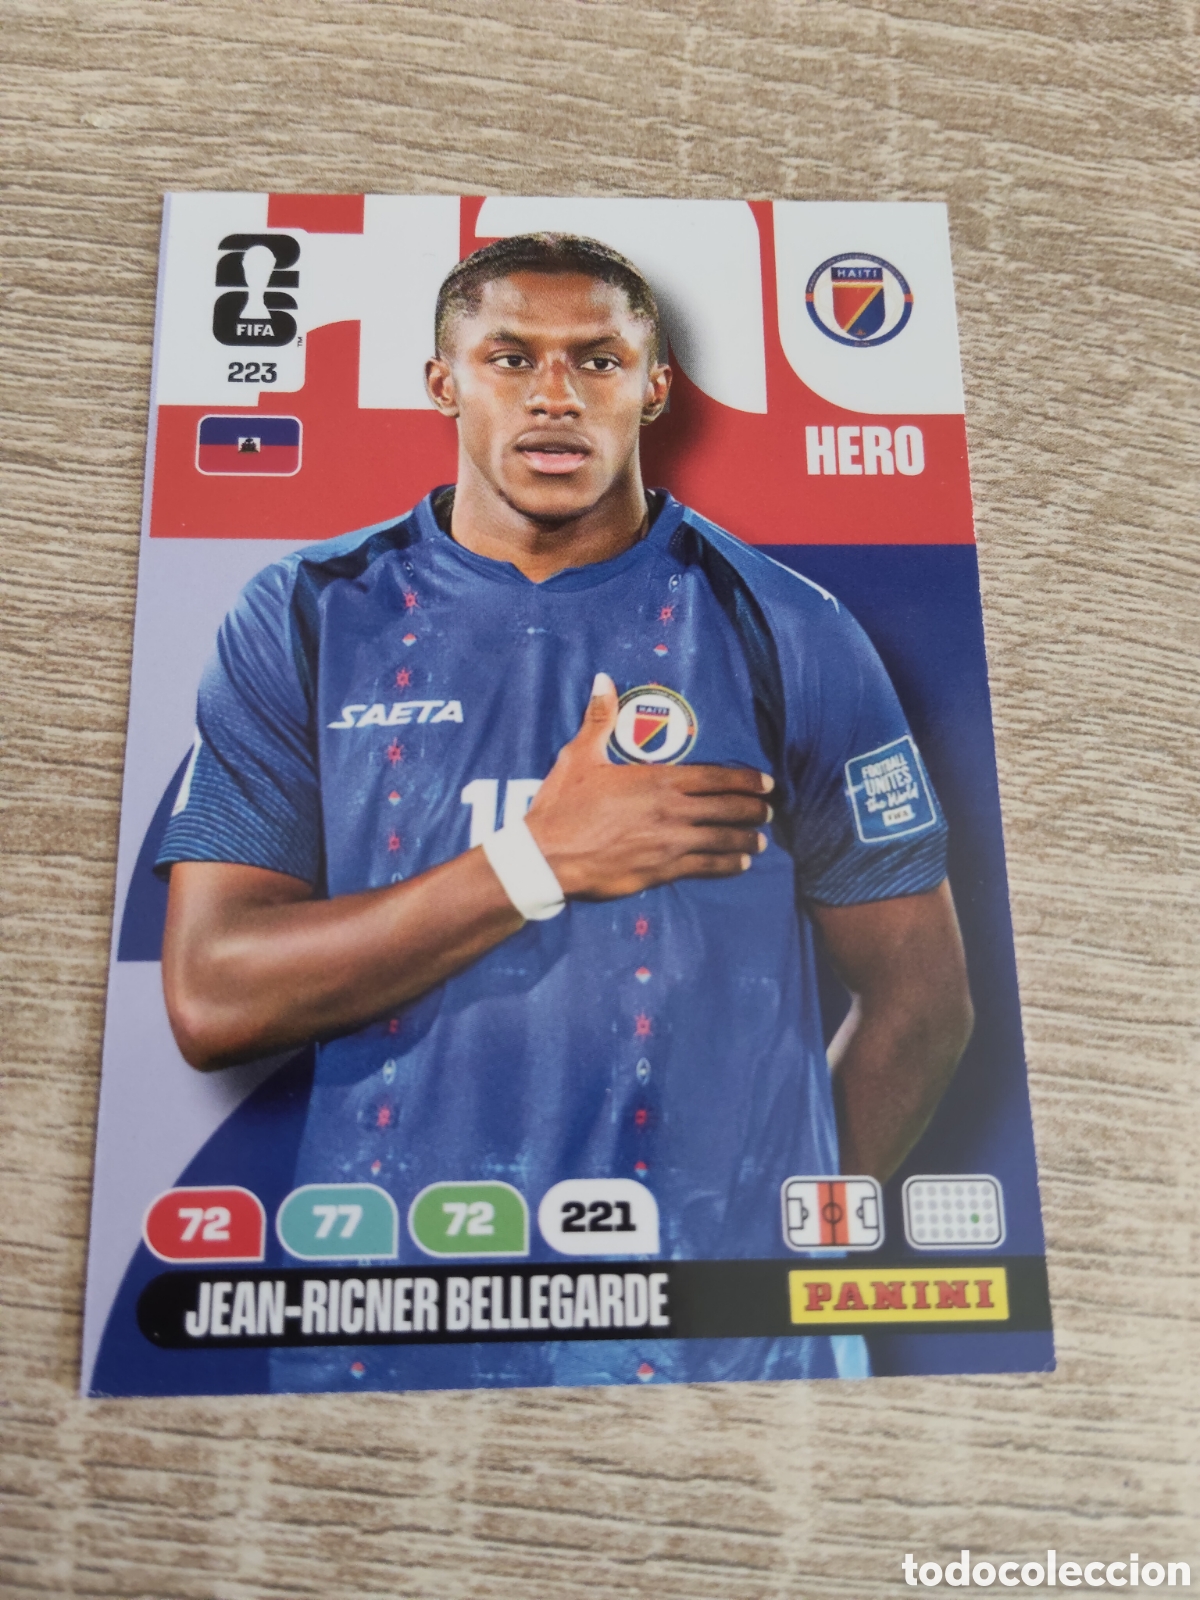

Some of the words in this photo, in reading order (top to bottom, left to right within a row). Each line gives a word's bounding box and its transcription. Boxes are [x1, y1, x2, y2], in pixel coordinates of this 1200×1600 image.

[838, 269, 876, 278] HAITI
[237, 324, 275, 336] FIFA
[228, 362, 277, 383] 223
[805, 426, 925, 475] HERO
[327, 700, 463, 729] SAETA
[178, 1207, 230, 1242] 72
[312, 1204, 363, 1239] 77
[442, 1202, 495, 1237] 72
[560, 1200, 636, 1233] 221
[186, 1277, 439, 1337] JEAN-RICNER
[446, 1273, 670, 1332] BELLEGARDE
[804, 1280, 995, 1311] PANINI
